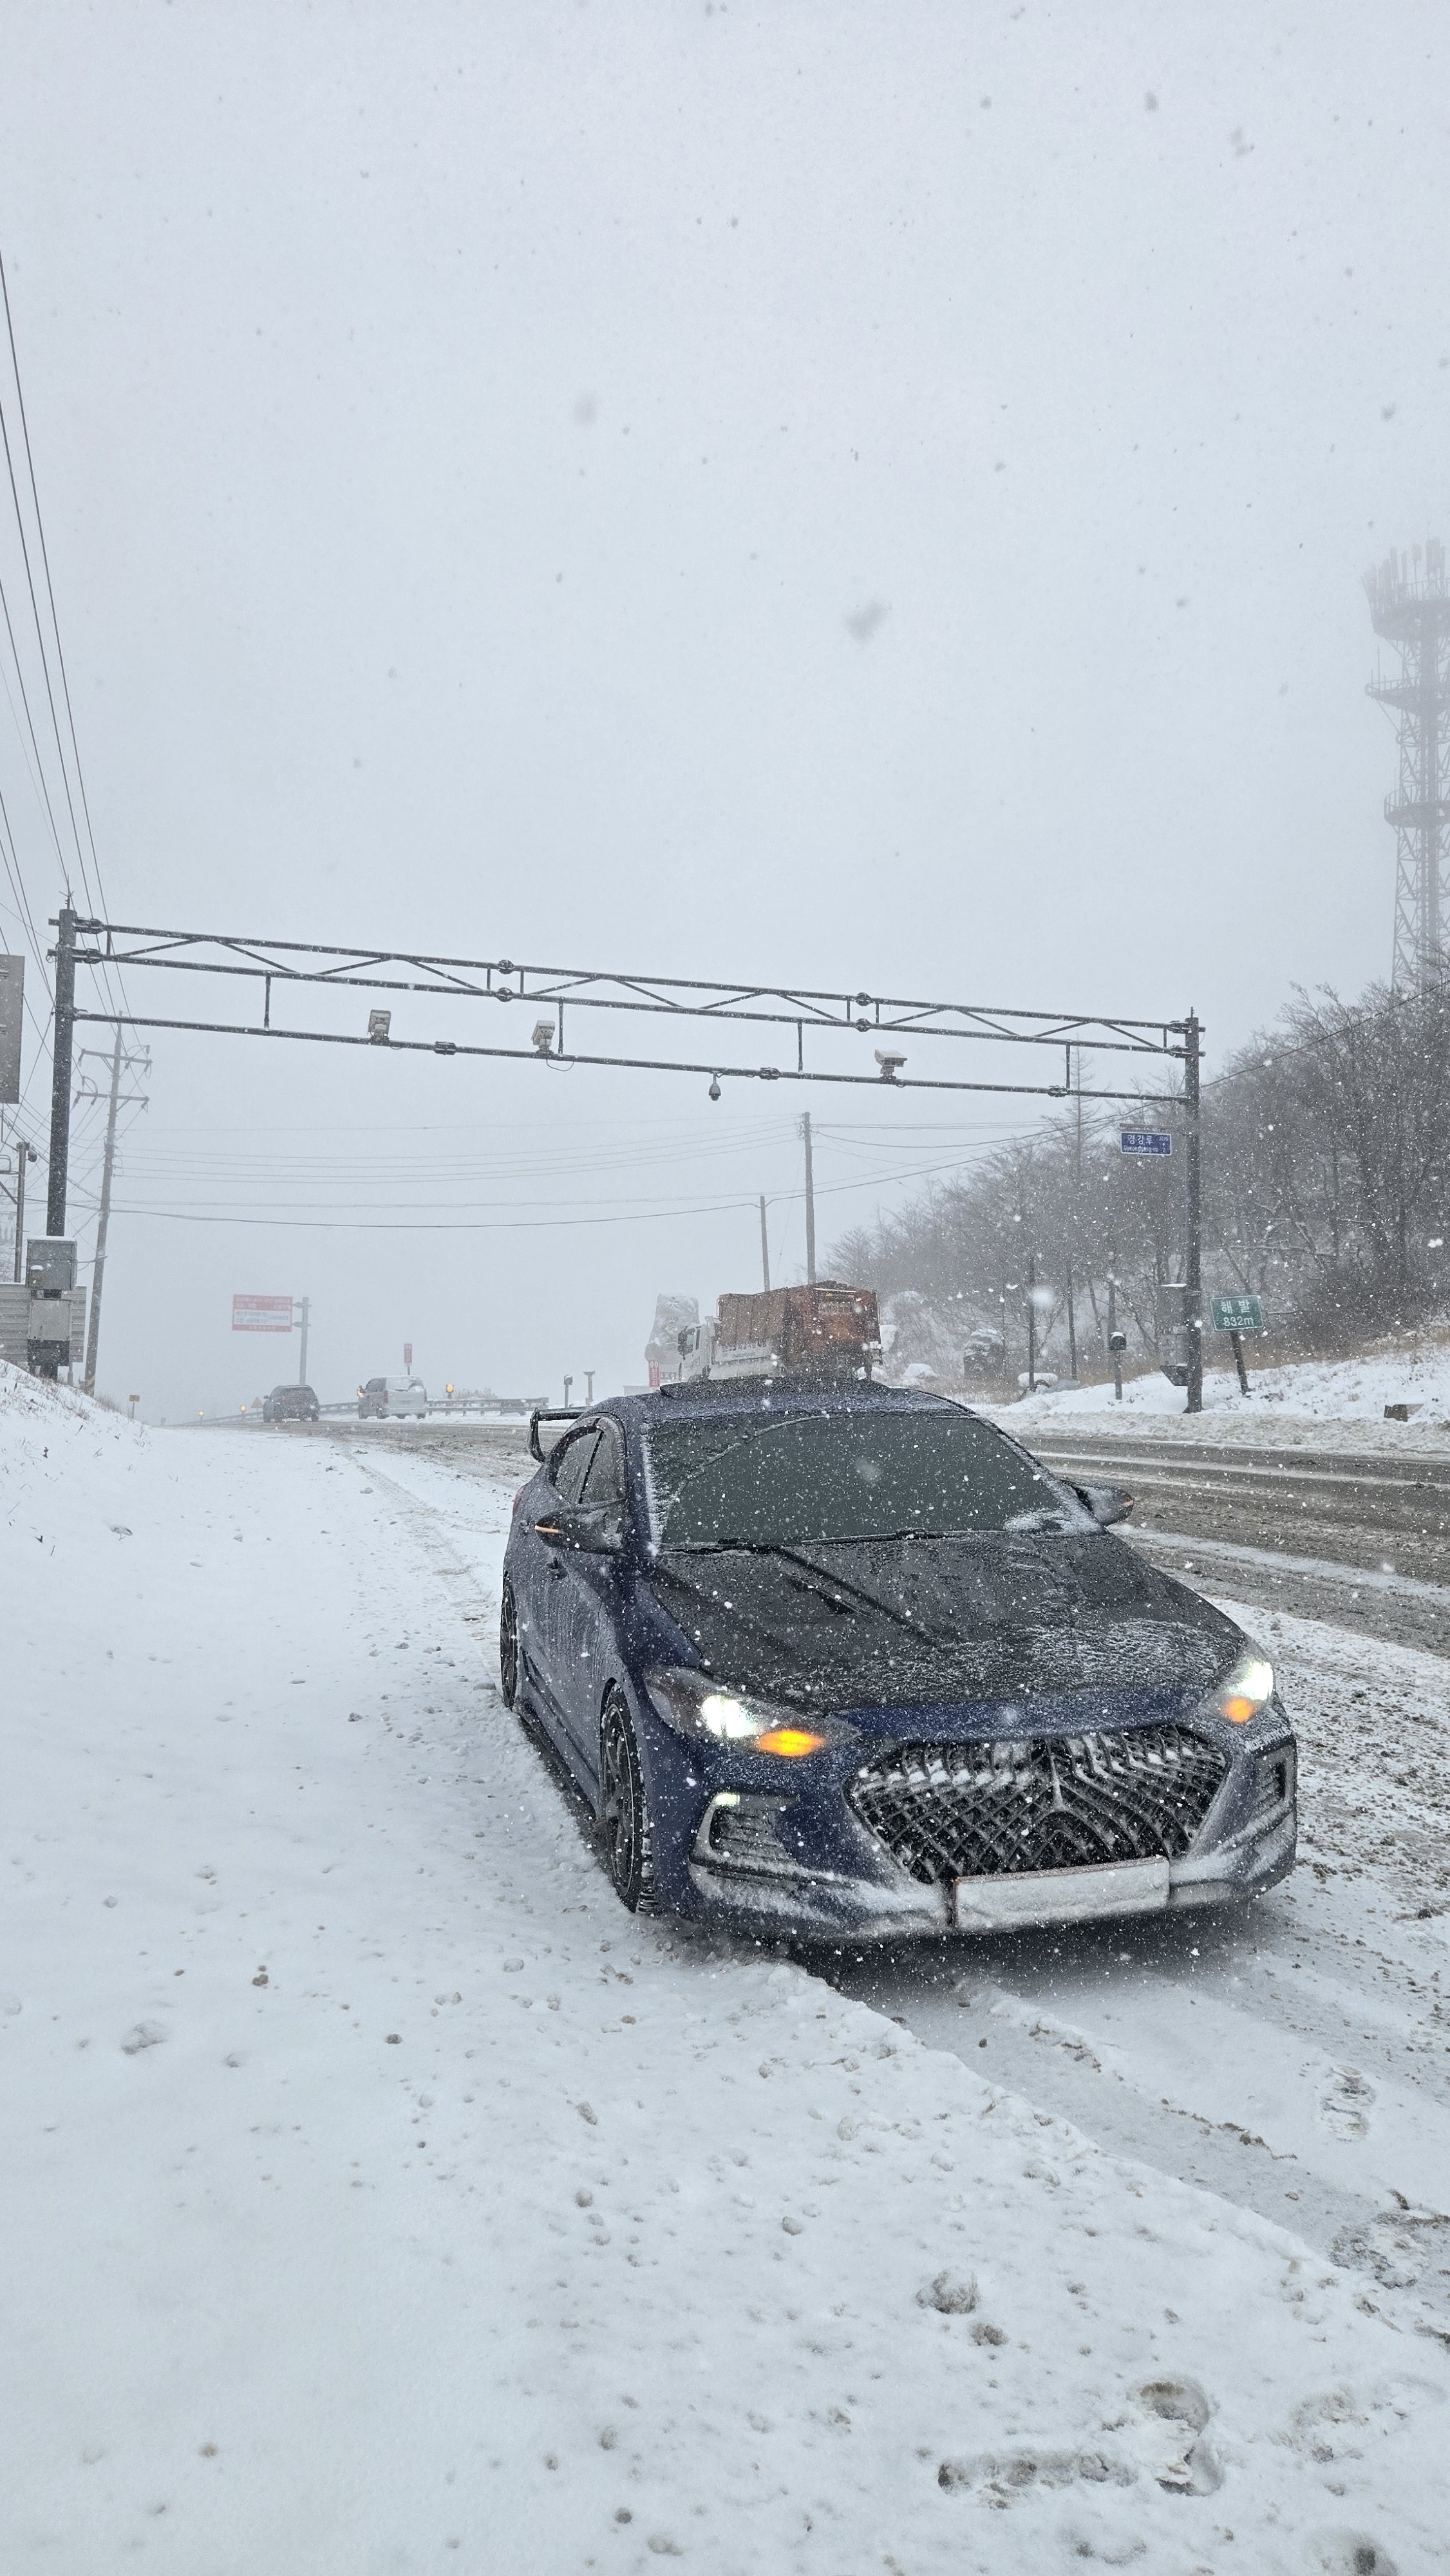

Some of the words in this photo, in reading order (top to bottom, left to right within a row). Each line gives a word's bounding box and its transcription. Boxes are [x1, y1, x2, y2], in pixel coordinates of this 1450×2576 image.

[1127, 1135, 1153, 1145] 경강로
[1220, 1300, 1250, 1314] 해발
[1223, 1316, 1254, 1327] 832m
